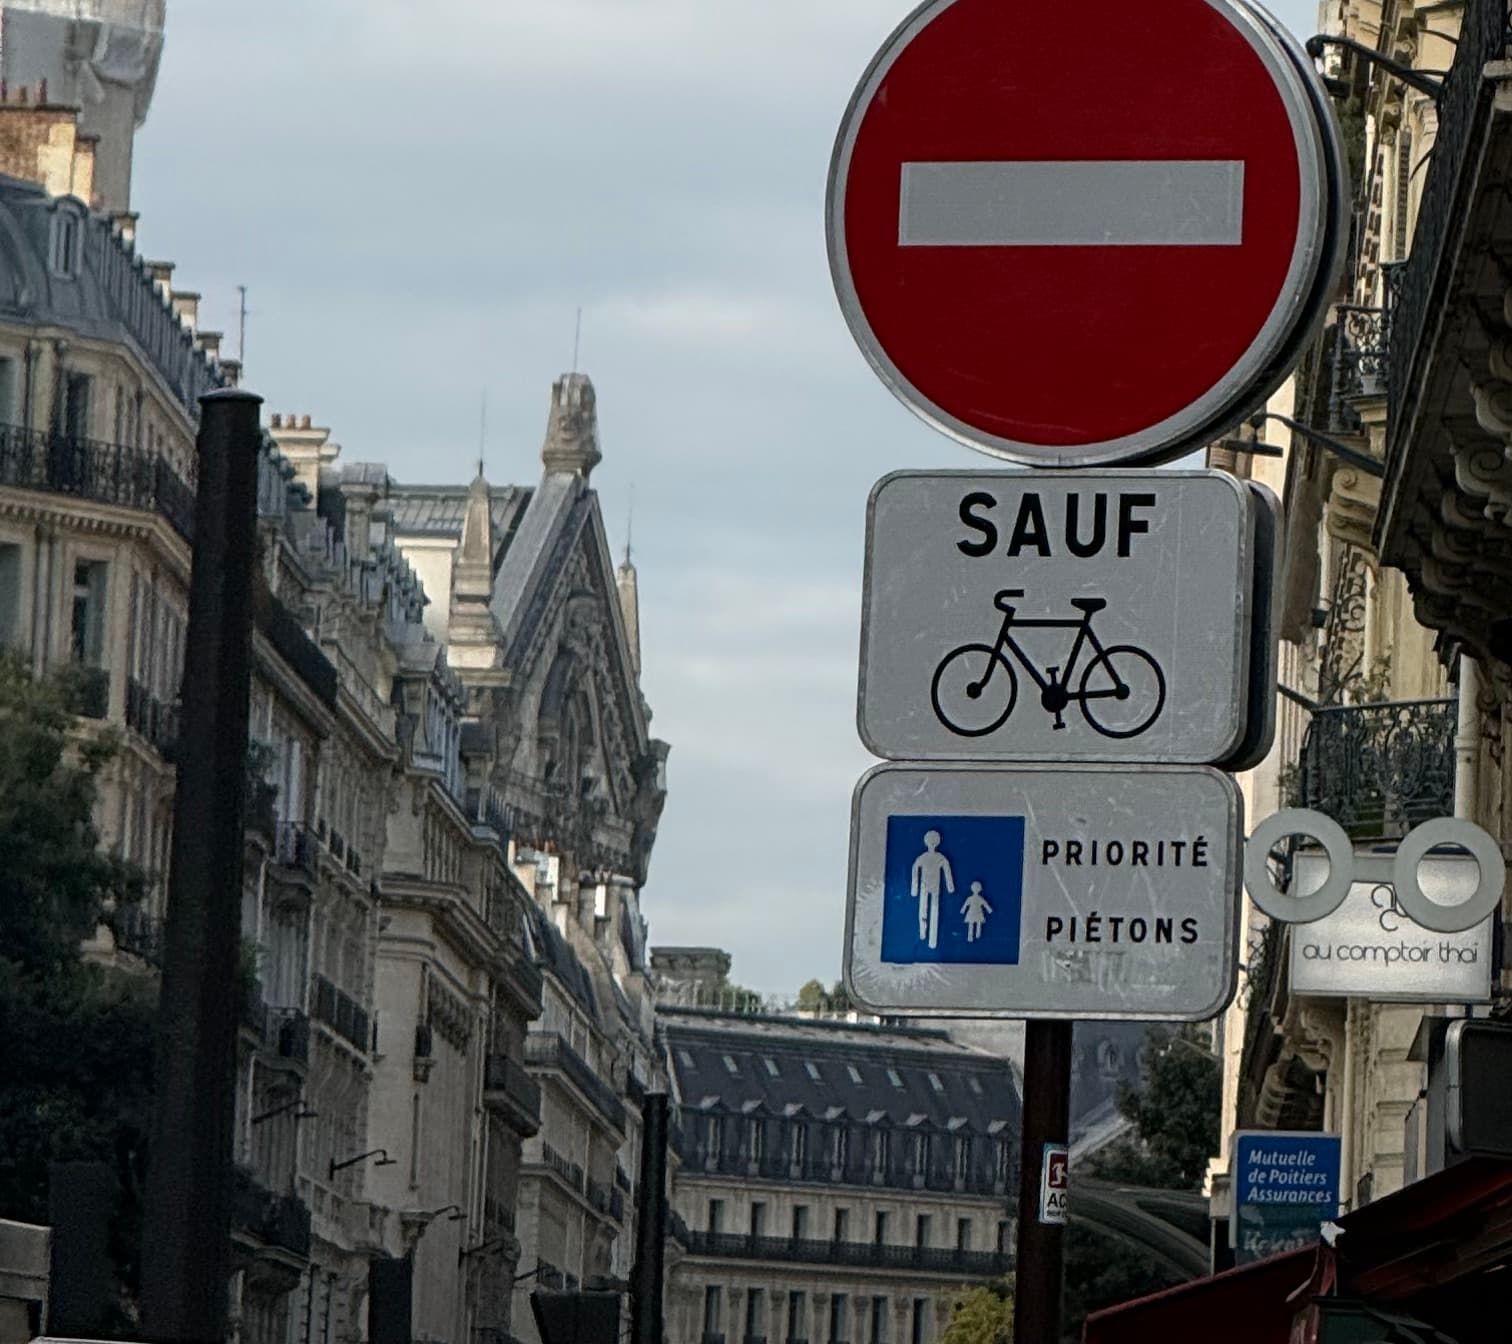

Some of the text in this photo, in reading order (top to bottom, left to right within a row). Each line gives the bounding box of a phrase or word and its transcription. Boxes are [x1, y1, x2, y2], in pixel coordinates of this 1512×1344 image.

[956, 491, 1156, 558] SAUF
[1042, 835, 1209, 868] PRIORITÉ
[1045, 912, 1200, 944] PIÉTONS
[1302, 943, 1333, 961] au
[1336, 940, 1433, 967] comptoir
[1248, 1149, 1316, 1166] Mutuelle
[1247, 1168, 1328, 1185] de Poitiers
[1247, 1185, 1333, 1203] Assurances
